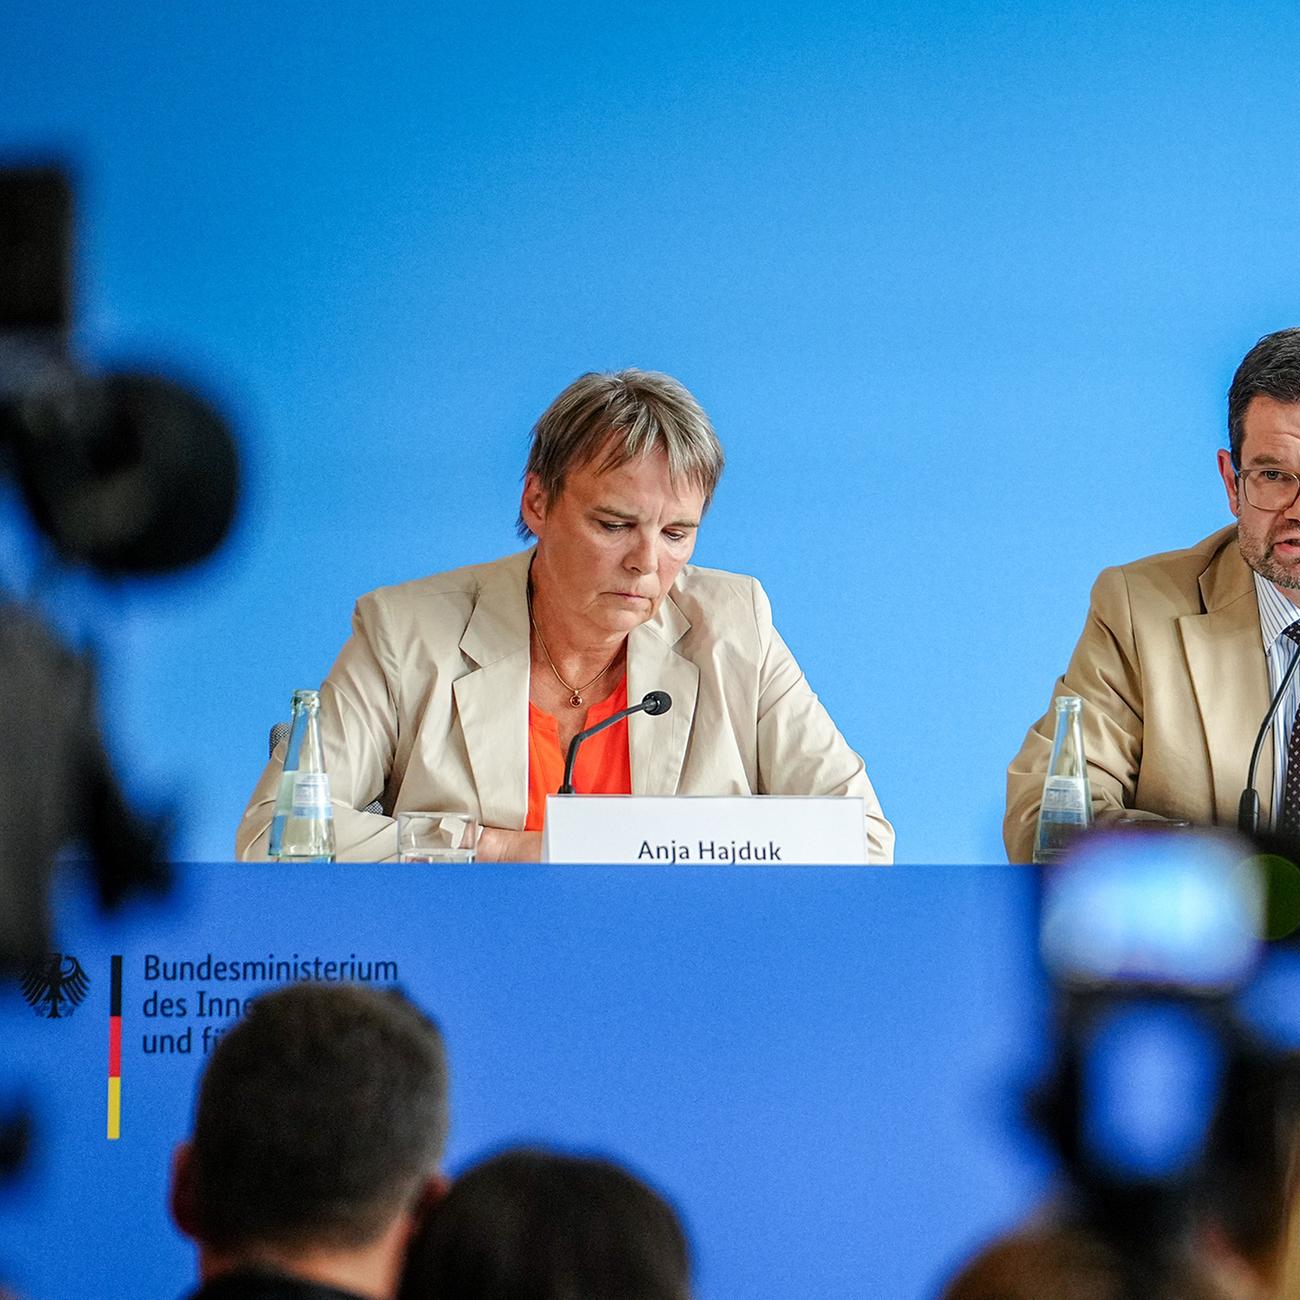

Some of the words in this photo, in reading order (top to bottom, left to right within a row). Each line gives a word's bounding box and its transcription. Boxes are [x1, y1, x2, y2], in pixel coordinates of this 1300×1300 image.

[638, 840, 690, 864] Anja
[699, 840, 782, 864] Hajduk
[144, 954, 398, 982] Bundesministerium
[143, 990, 187, 1017] des
[142, 1026, 192, 1054] und
